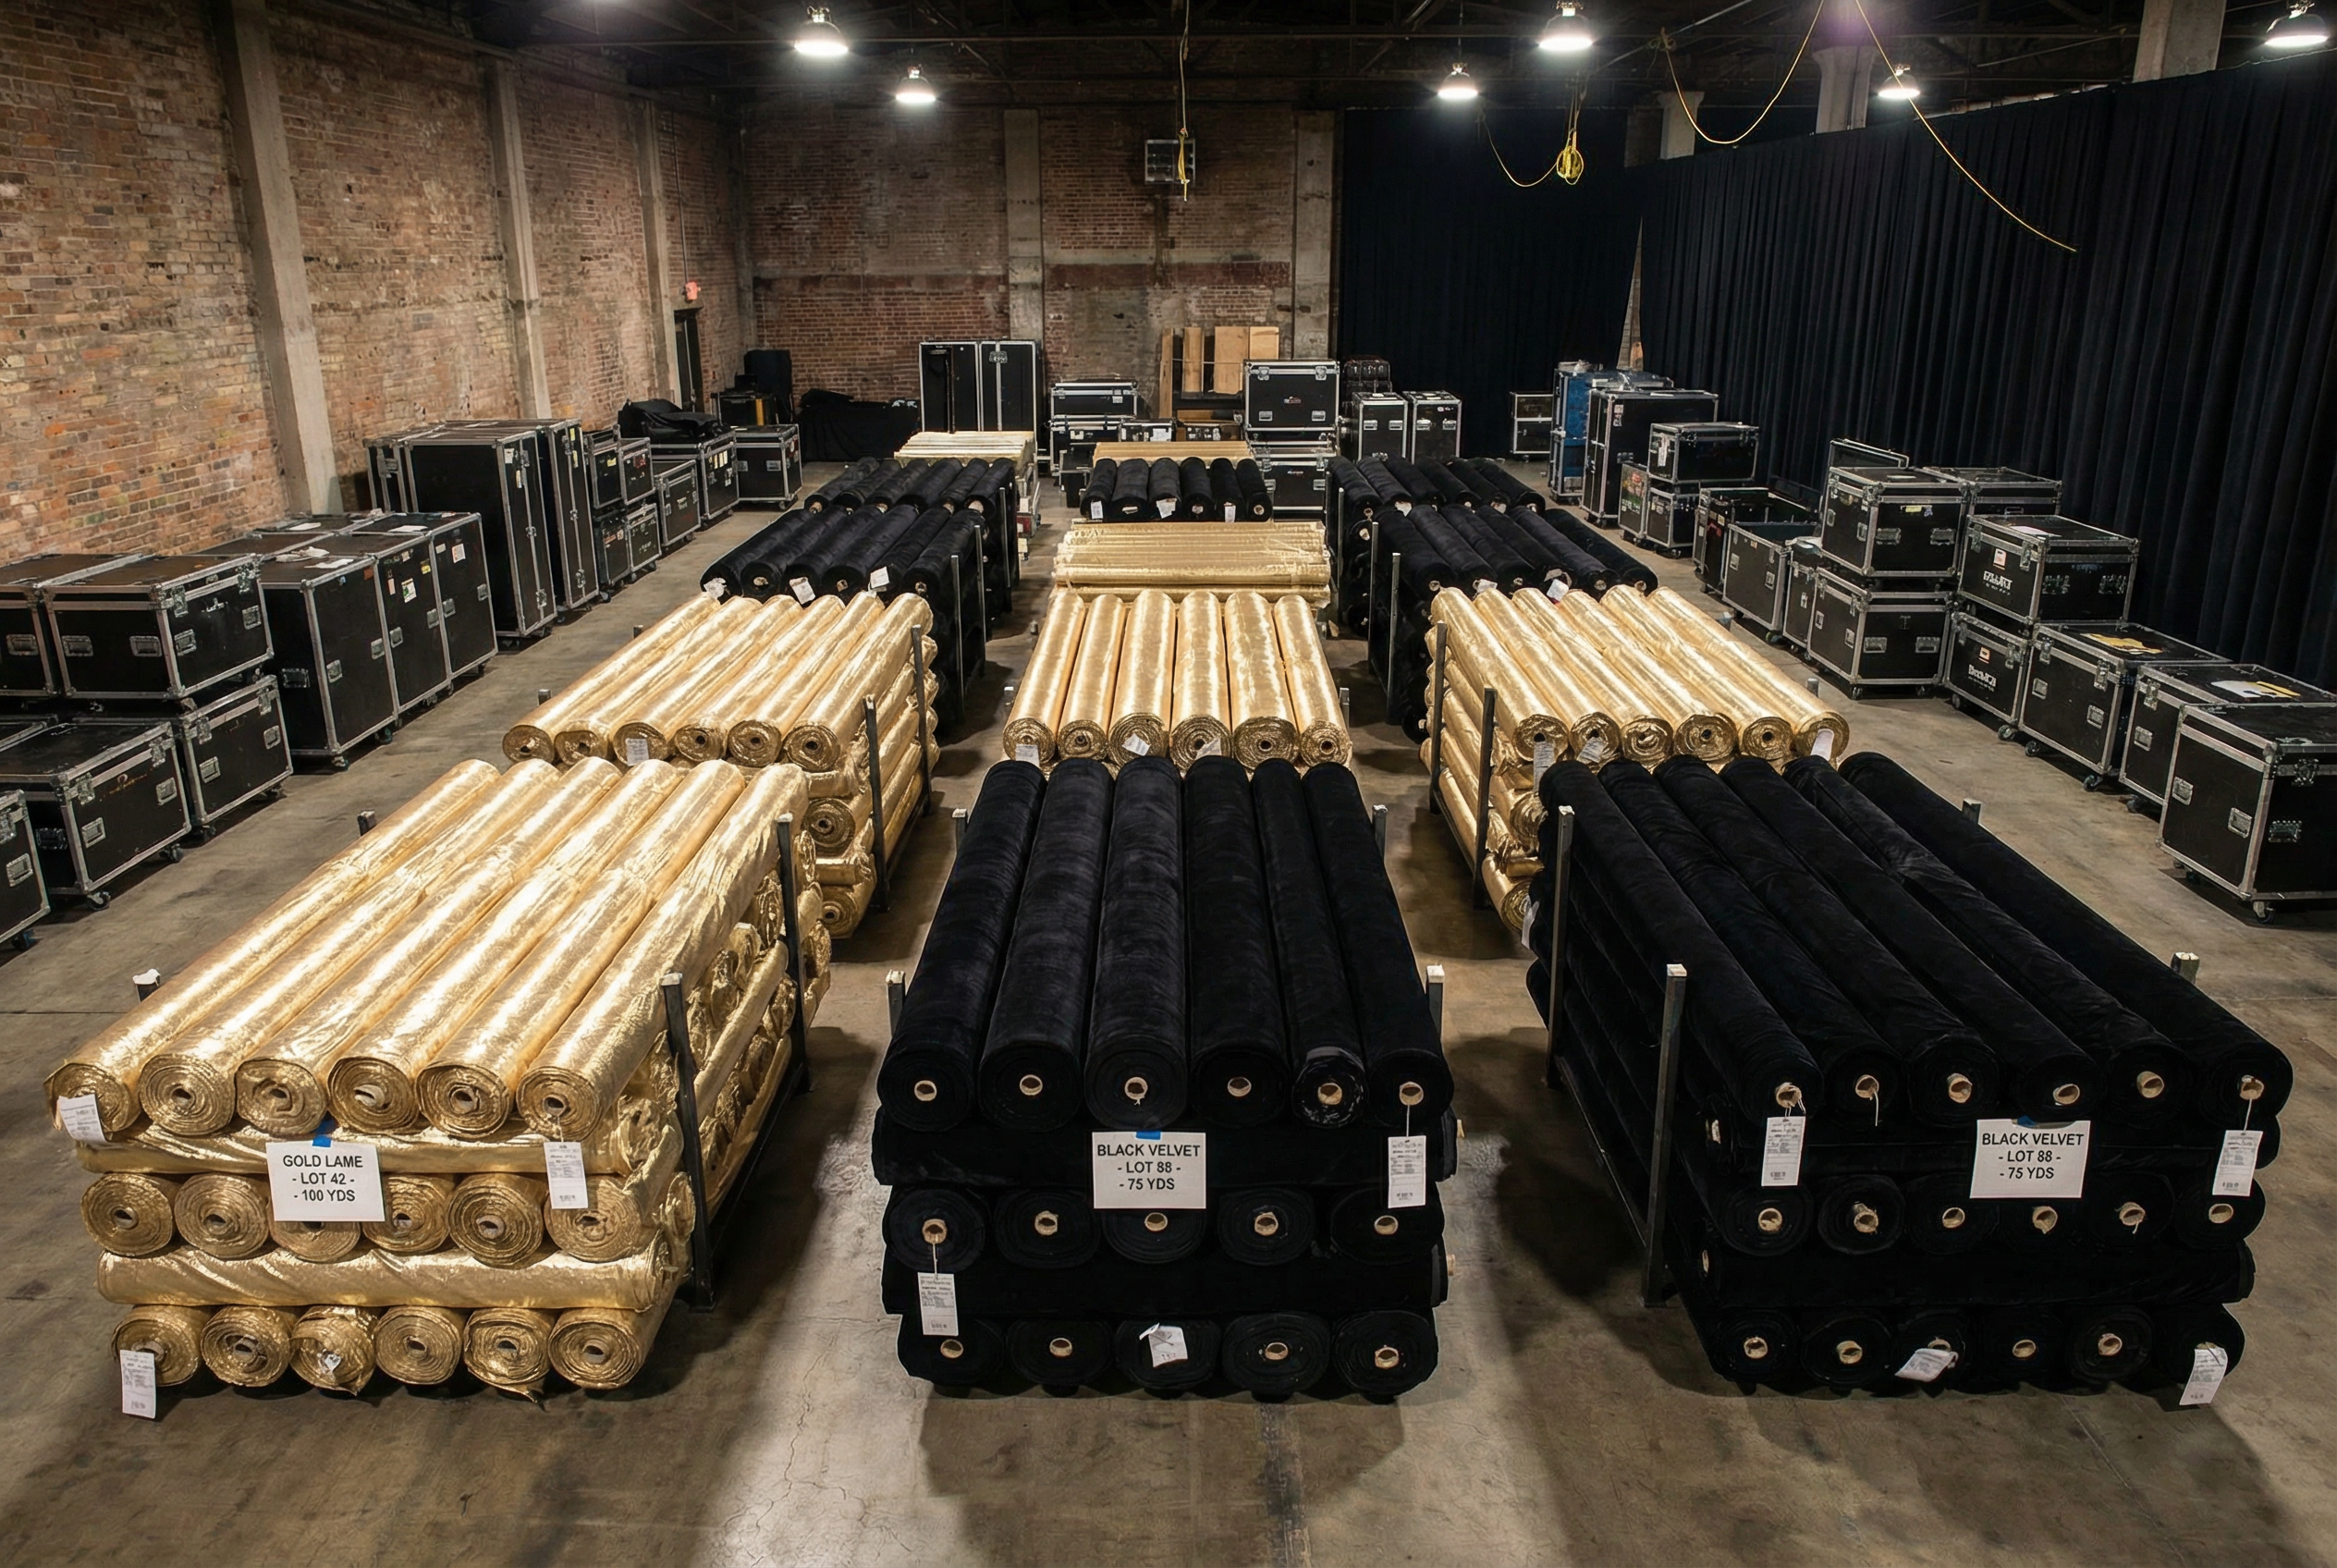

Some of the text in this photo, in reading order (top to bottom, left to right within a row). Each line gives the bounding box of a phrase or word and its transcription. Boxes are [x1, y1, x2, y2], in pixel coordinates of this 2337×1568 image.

[1982, 1133, 2085, 1145] BLACK VELVET
[1097, 1144, 1201, 1157] BLACK VELVET
[2007, 1150, 2035, 1162] LOT
[2037, 1150, 2052, 1162] 88
[282, 1155, 363, 1168] GOLD LAME
[1126, 1161, 1154, 1173] LOT
[1156, 1161, 1172, 1173] 88
[300, 1172, 327, 1184] LOT
[330, 1172, 347, 1184] 42
[2008, 1167, 2024, 1179] 75
[2026, 1167, 2054, 1179] YDS
[1127, 1178, 1144, 1190] 75
[1146, 1178, 1175, 1190] YDS
[301, 1189, 324, 1201] 100
[326, 1189, 356, 1201] YDS
